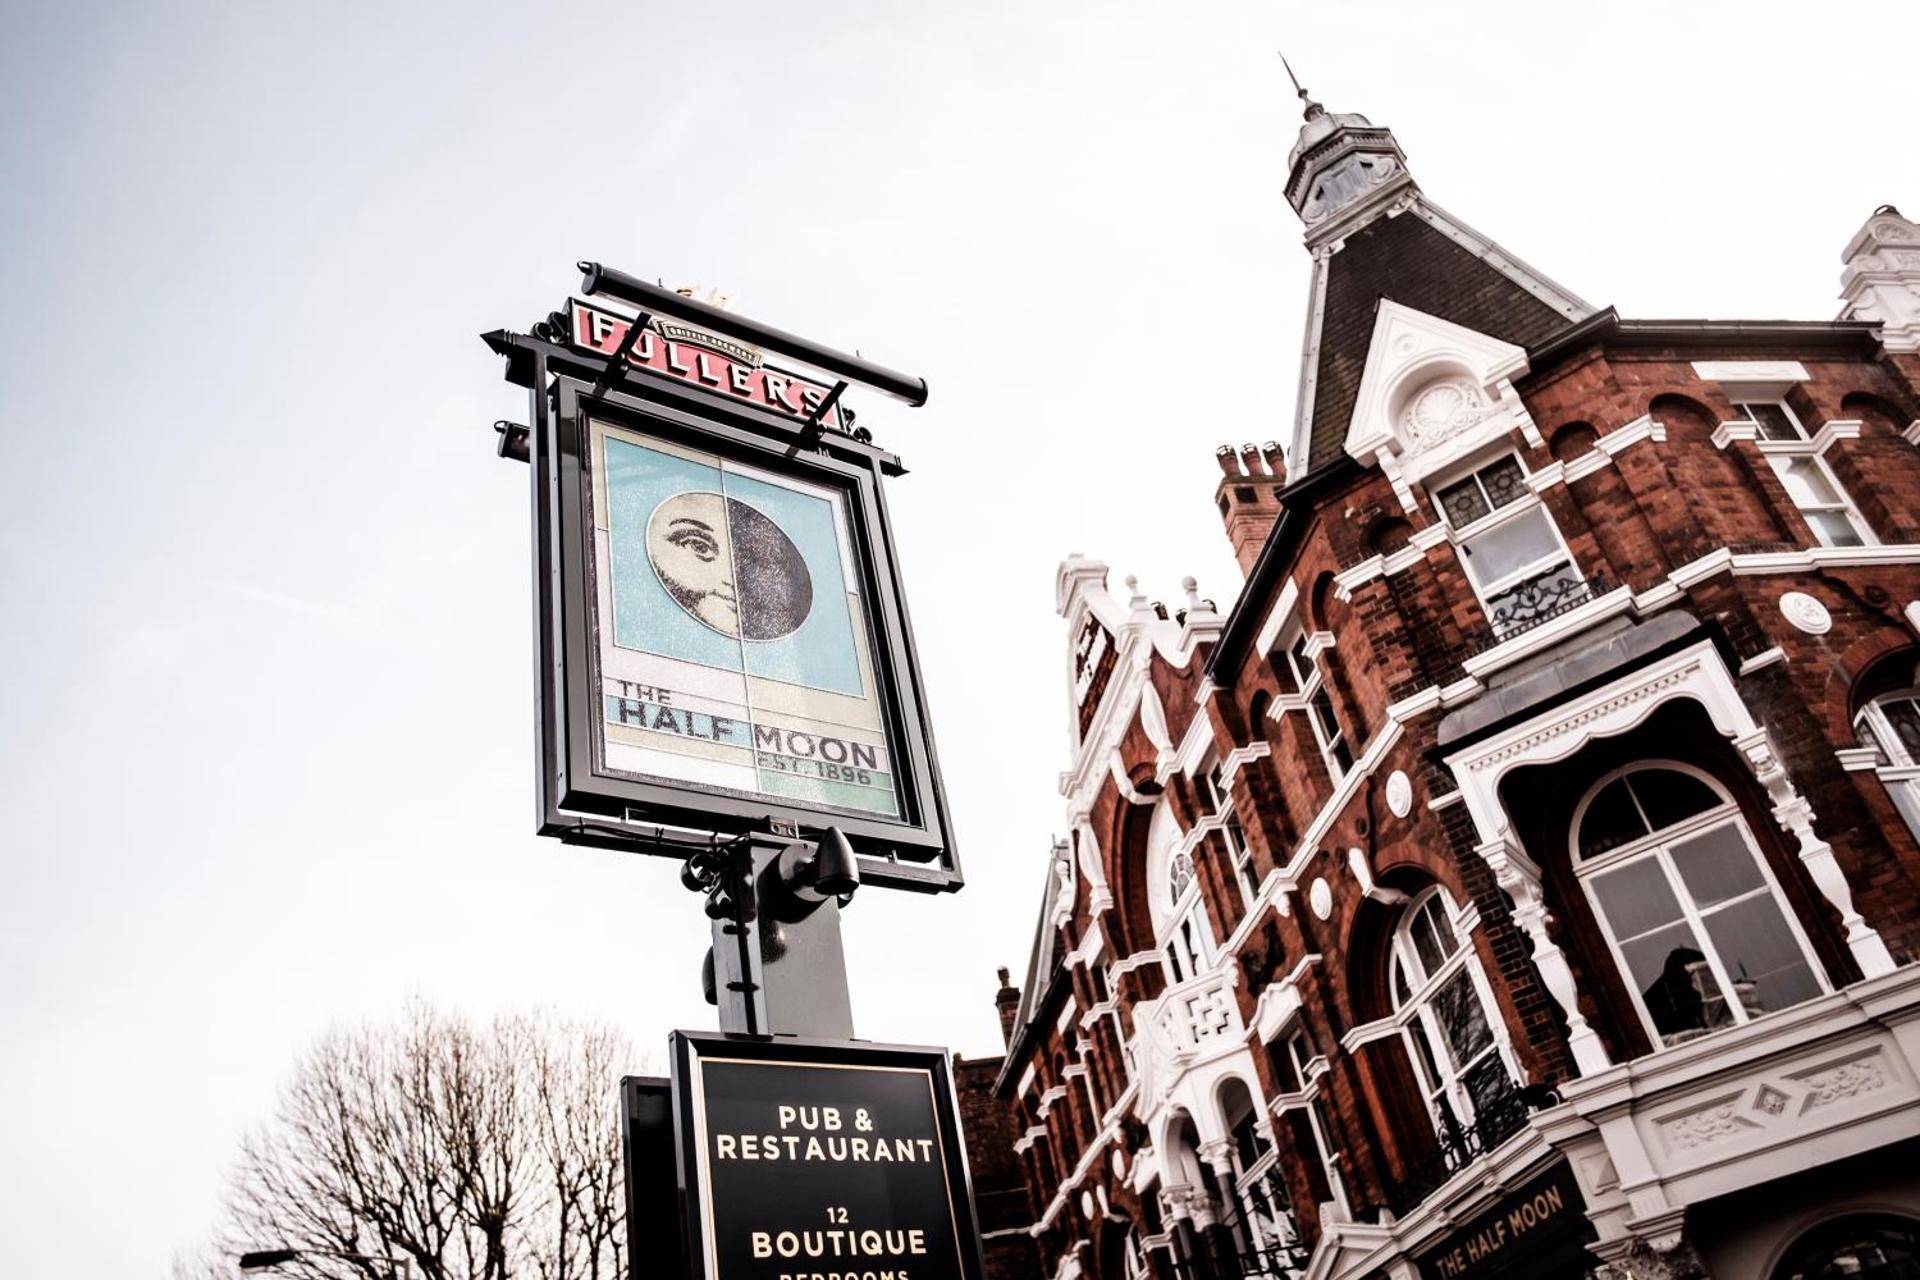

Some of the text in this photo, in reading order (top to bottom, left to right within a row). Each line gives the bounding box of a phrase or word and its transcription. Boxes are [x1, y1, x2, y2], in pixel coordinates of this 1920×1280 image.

[617, 680, 672, 704] THE
[618, 698, 877, 769] HALF MOON
[817, 761, 872, 785] 1896
[779, 1105, 873, 1131] PUB &
[717, 1134, 933, 1162] RESTAURANT
[826, 1207, 849, 1224] 12
[752, 1230, 927, 1258] BOUTIQUE
[1436, 1185, 1564, 1280] THE HALF MOON
